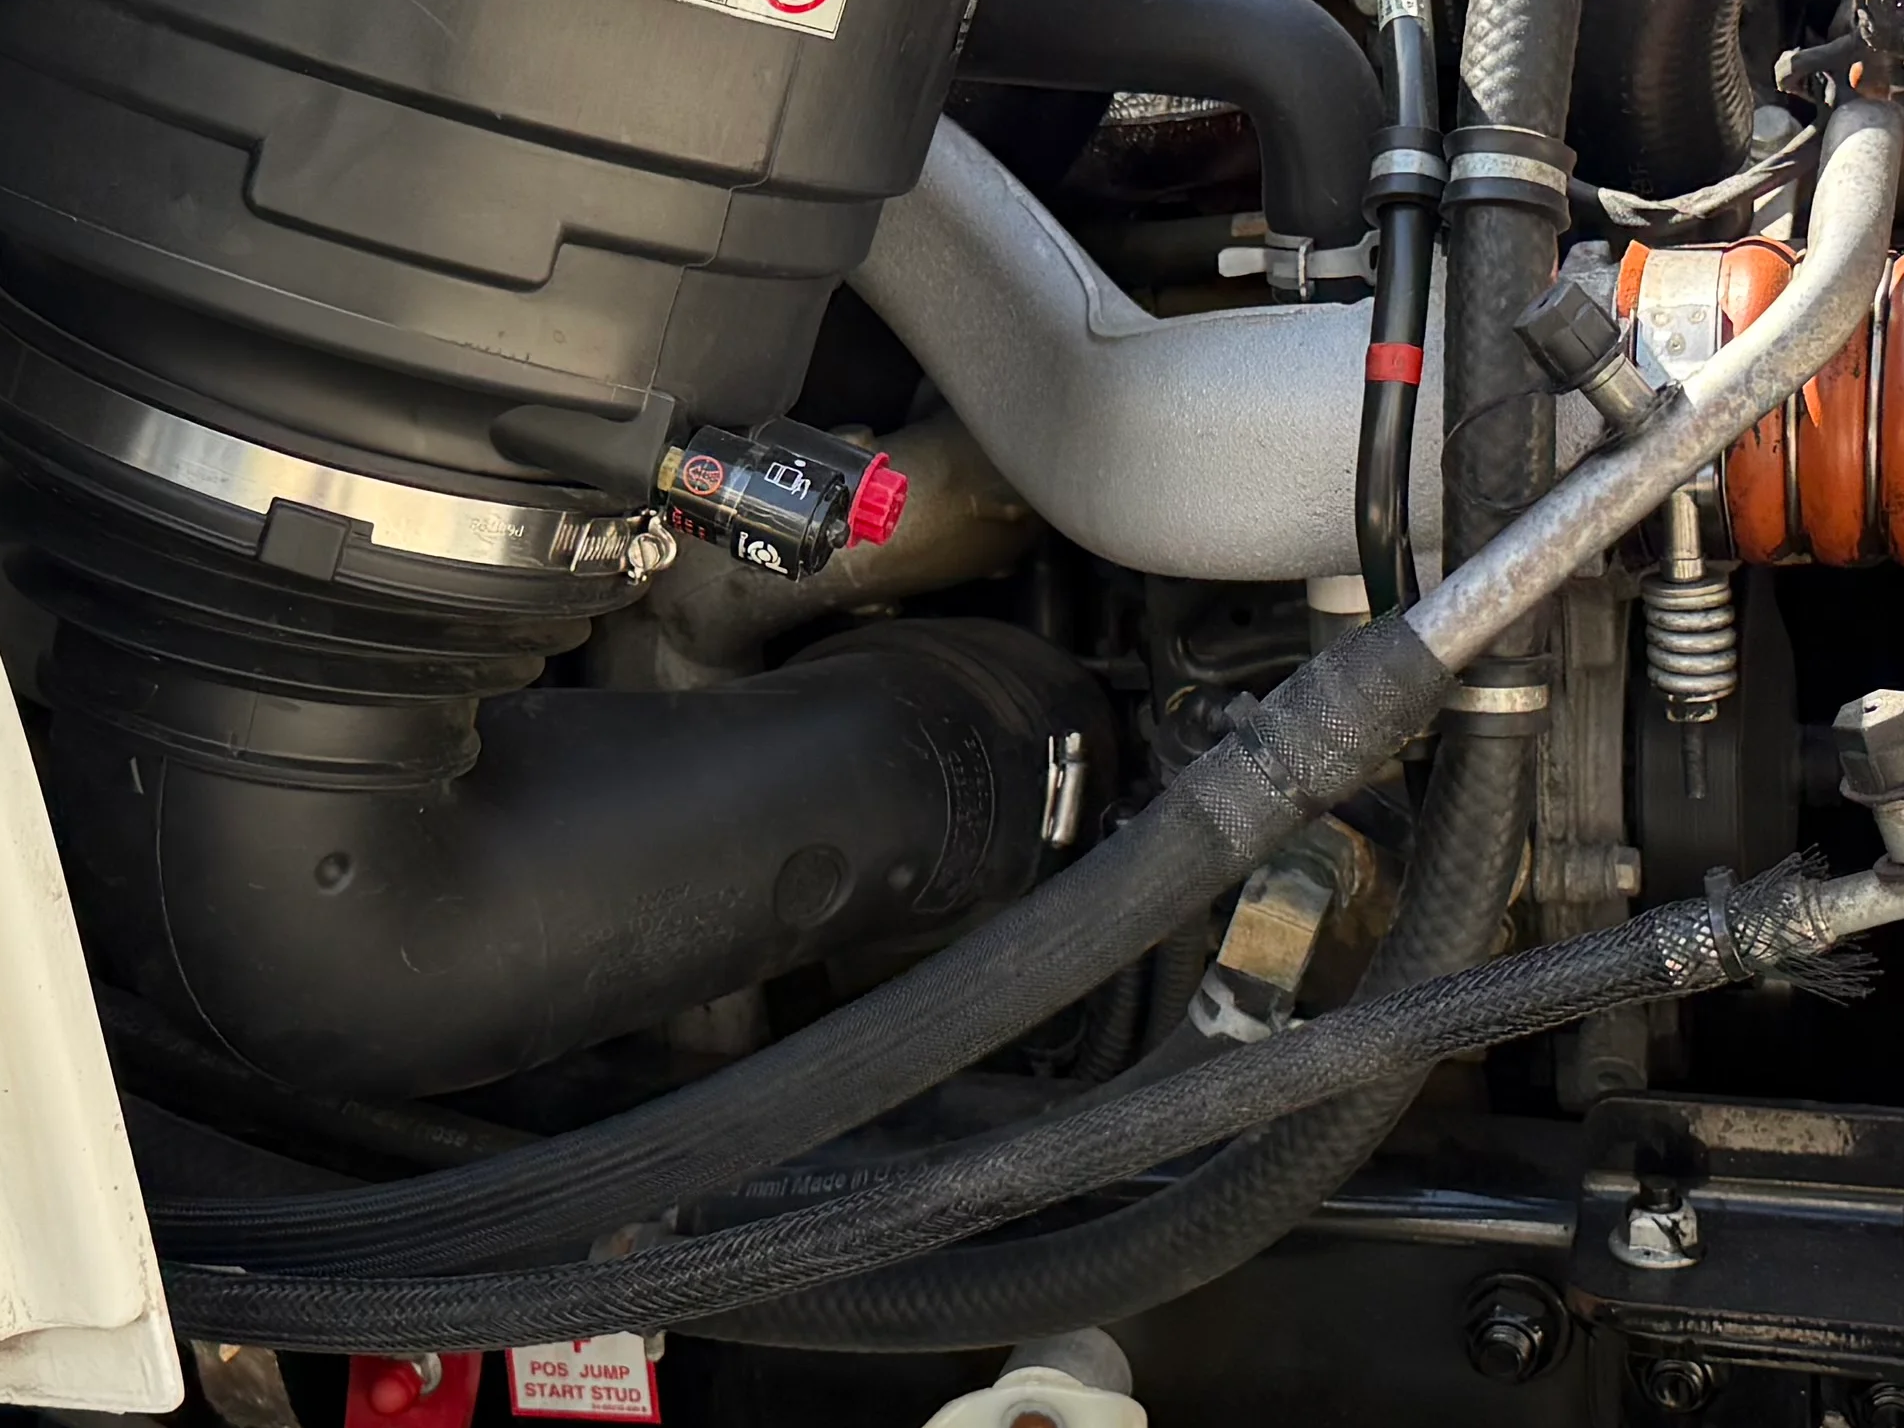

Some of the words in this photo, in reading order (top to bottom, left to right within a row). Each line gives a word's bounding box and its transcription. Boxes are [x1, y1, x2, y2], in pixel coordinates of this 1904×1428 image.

[530, 1361, 568, 1377] POS
[579, 1364, 630, 1380] JUMP
[525, 1383, 585, 1399] START
[592, 1386, 641, 1402] STUD
